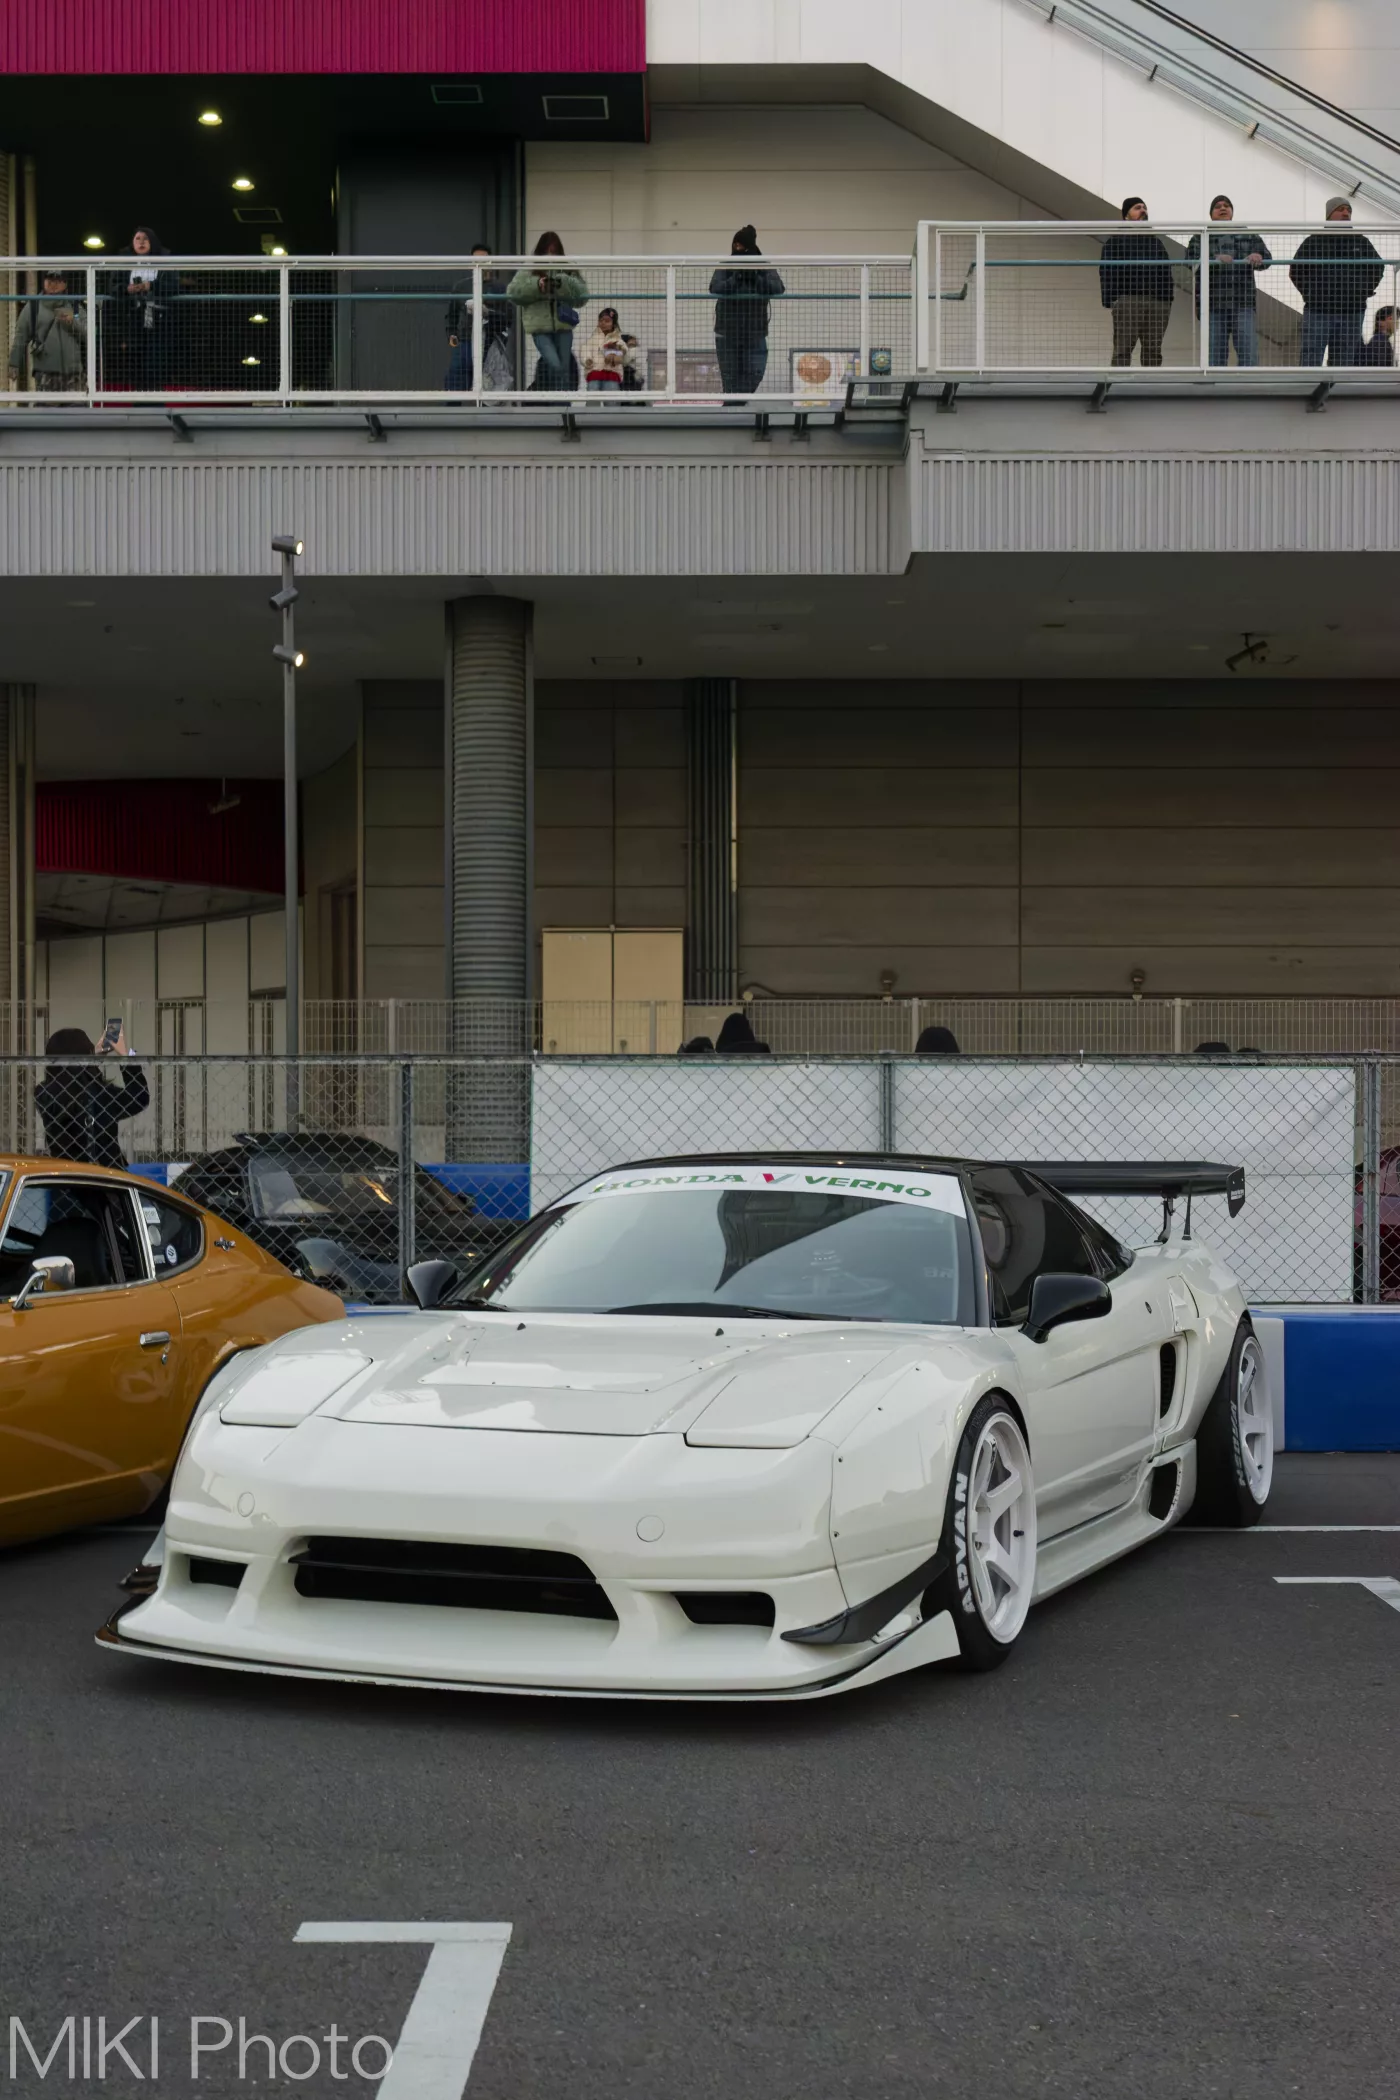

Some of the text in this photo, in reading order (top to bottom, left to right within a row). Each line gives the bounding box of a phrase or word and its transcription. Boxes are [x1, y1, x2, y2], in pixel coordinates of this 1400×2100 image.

[589, 1174, 747, 1194] HONDA
[804, 1175, 932, 1197] VERNO
[954, 1472, 976, 1614] ADVAN
